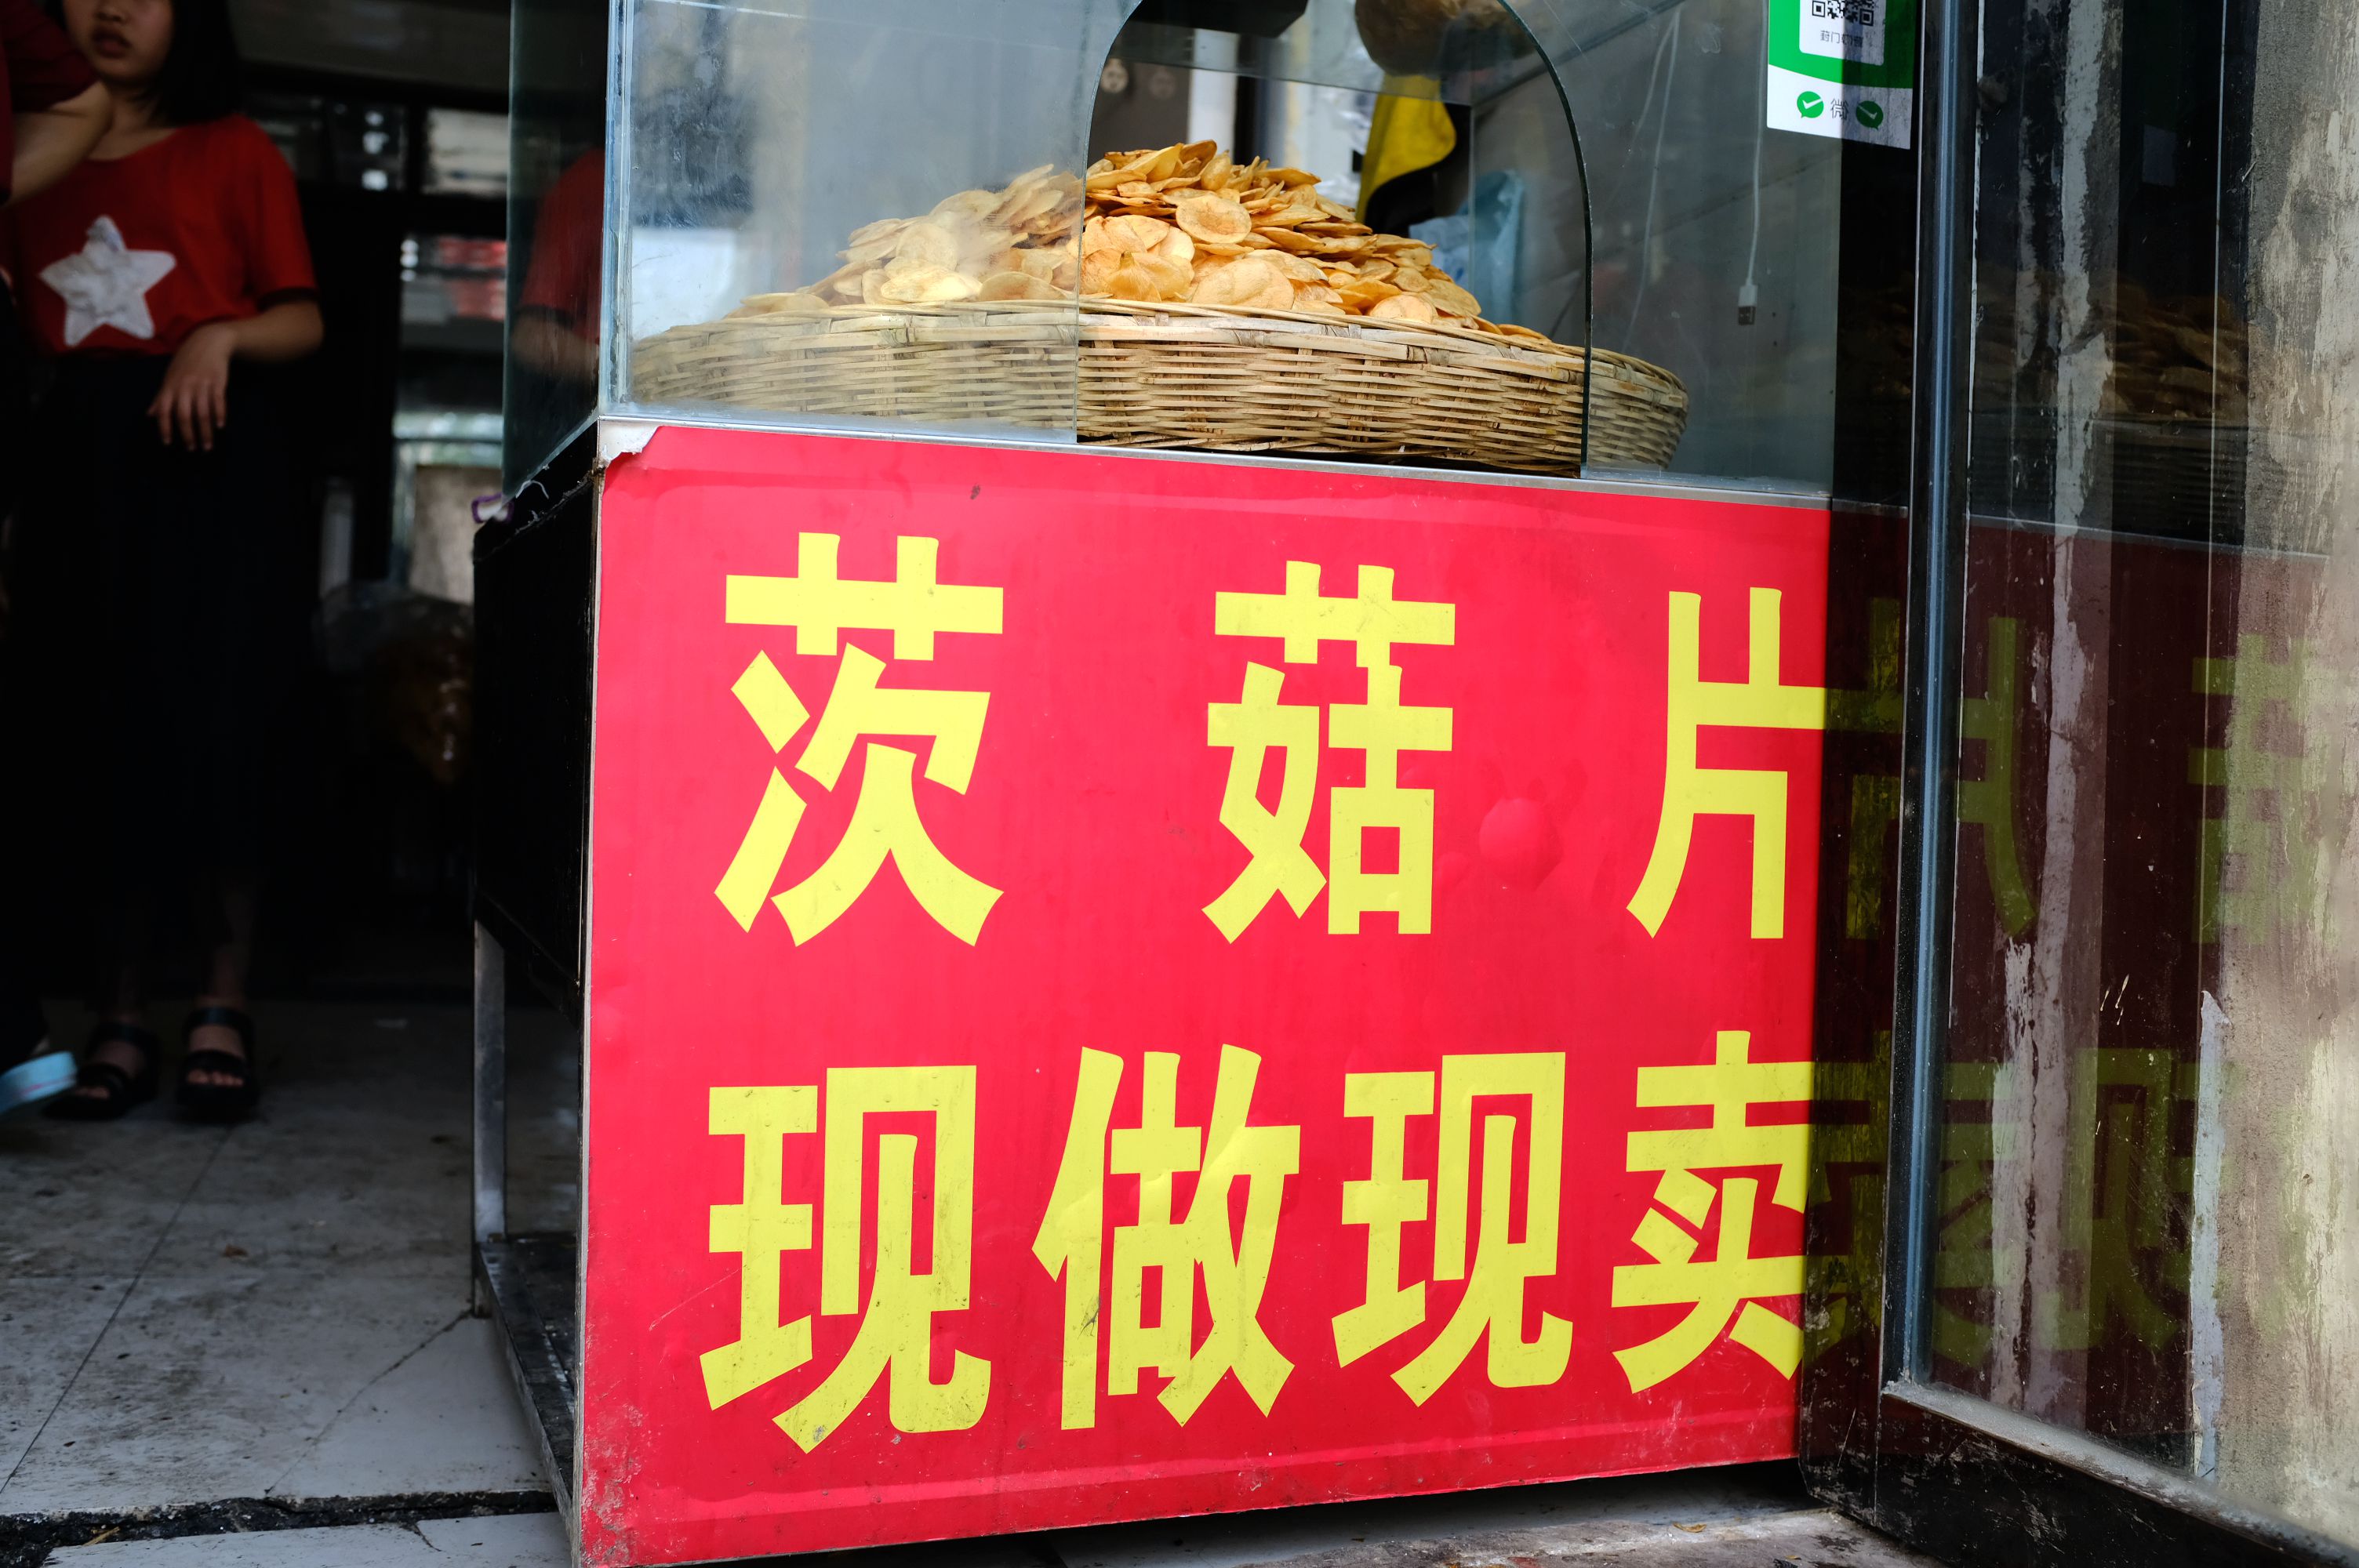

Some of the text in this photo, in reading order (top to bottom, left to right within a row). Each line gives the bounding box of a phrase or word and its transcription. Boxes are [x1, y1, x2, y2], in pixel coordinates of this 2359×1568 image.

[714, 532, 1826, 946] 茨菇片
[700, 1030, 1813, 1454] 现做现卖
